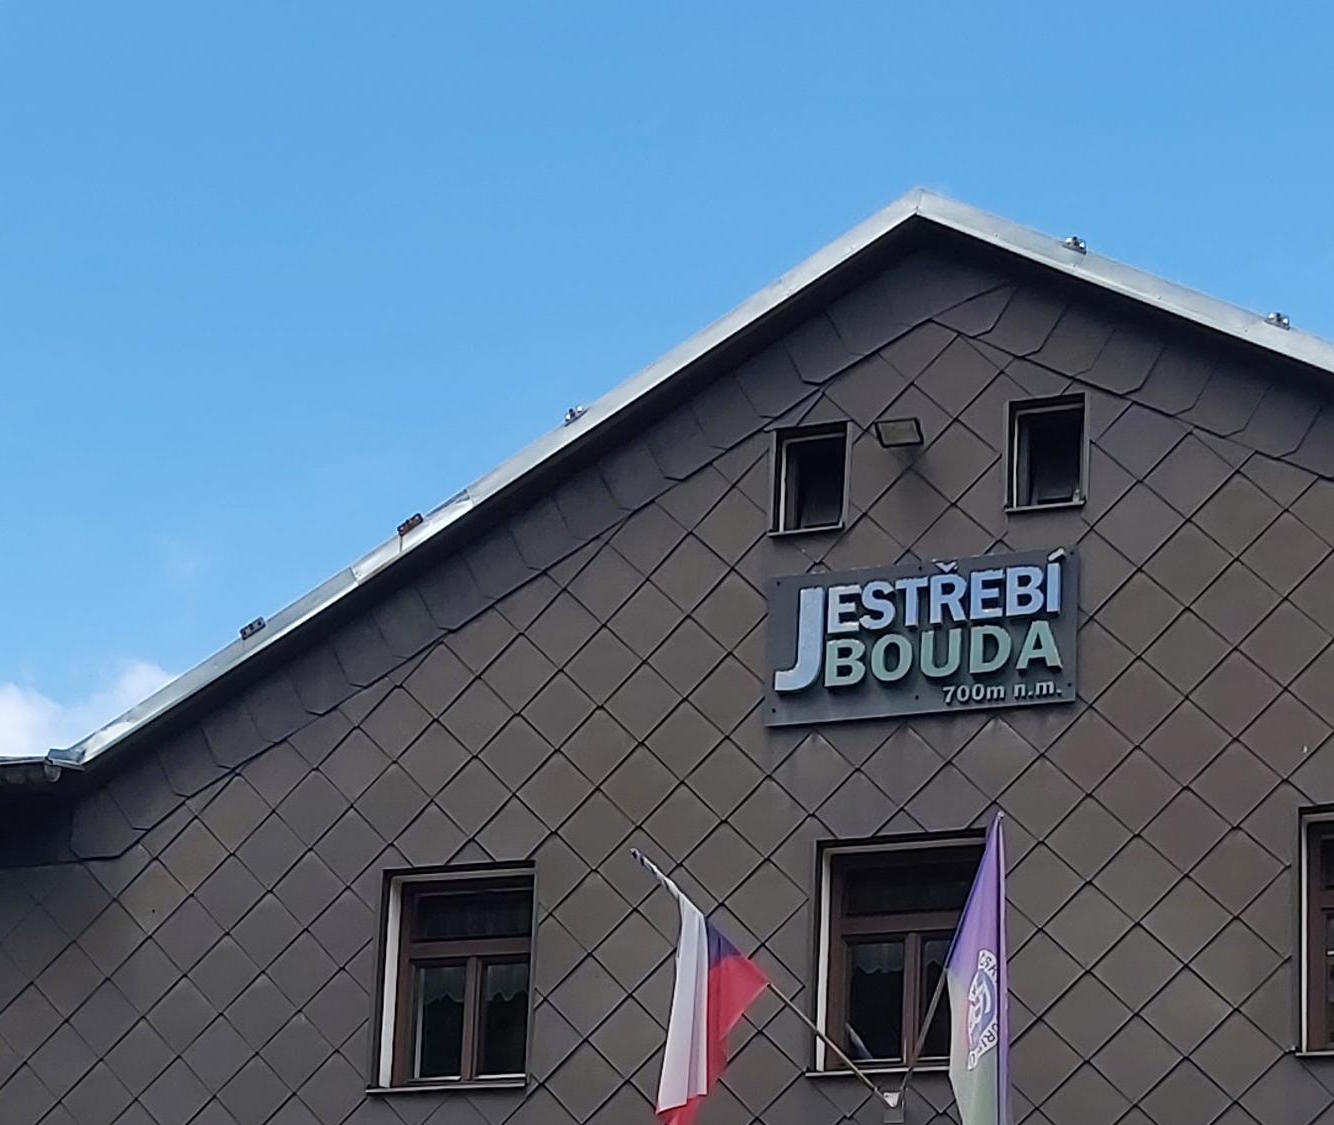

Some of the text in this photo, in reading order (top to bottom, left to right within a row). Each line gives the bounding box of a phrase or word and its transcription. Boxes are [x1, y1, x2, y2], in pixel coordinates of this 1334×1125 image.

[774, 547, 1065, 691] JESTŘEBÍ
[824, 621, 1063, 687] BOUDA
[943, 680, 1063, 704] 700m n.m.
